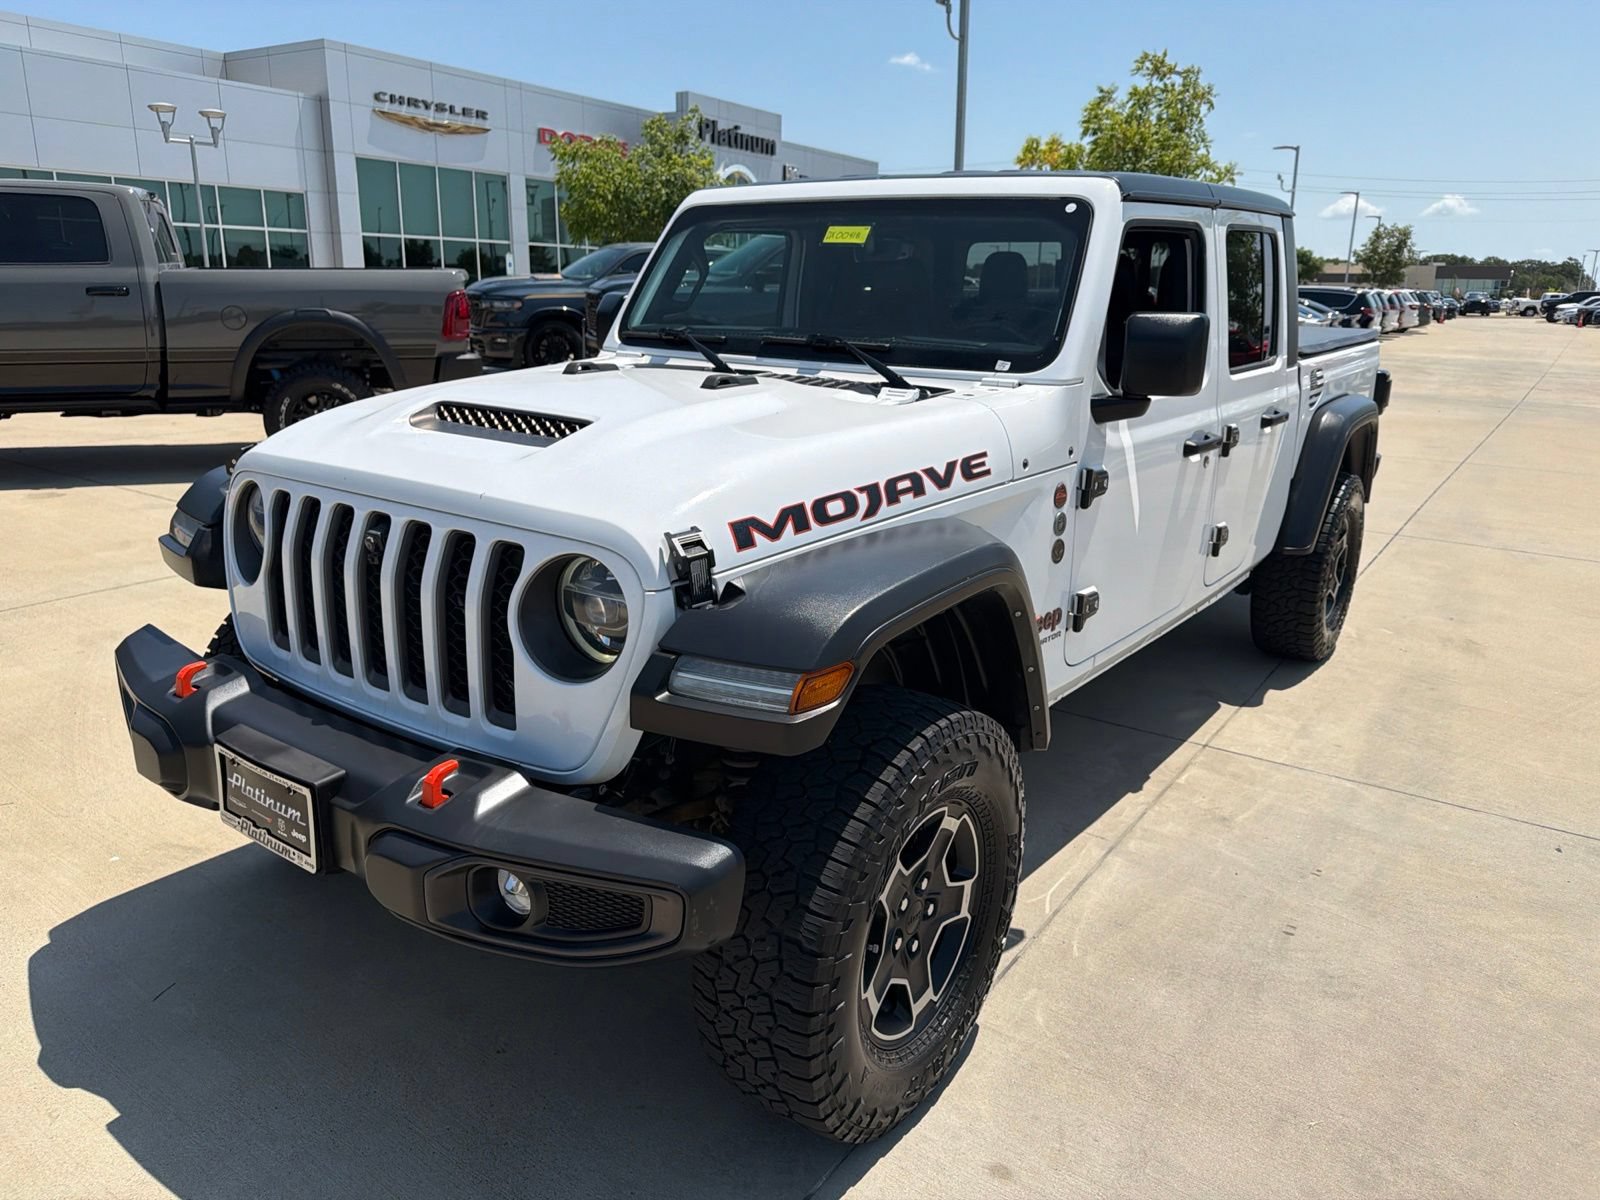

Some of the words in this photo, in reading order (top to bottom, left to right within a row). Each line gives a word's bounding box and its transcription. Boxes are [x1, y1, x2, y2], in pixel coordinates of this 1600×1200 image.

[373, 91, 489, 121] CHRYSLER
[698, 116, 777, 157] Platinum
[727, 450, 992, 553] MOJAVE
[227, 772, 306, 827] Platinum
[241, 819, 296, 862] Platinum
[291, 828, 307, 843] Jeep
